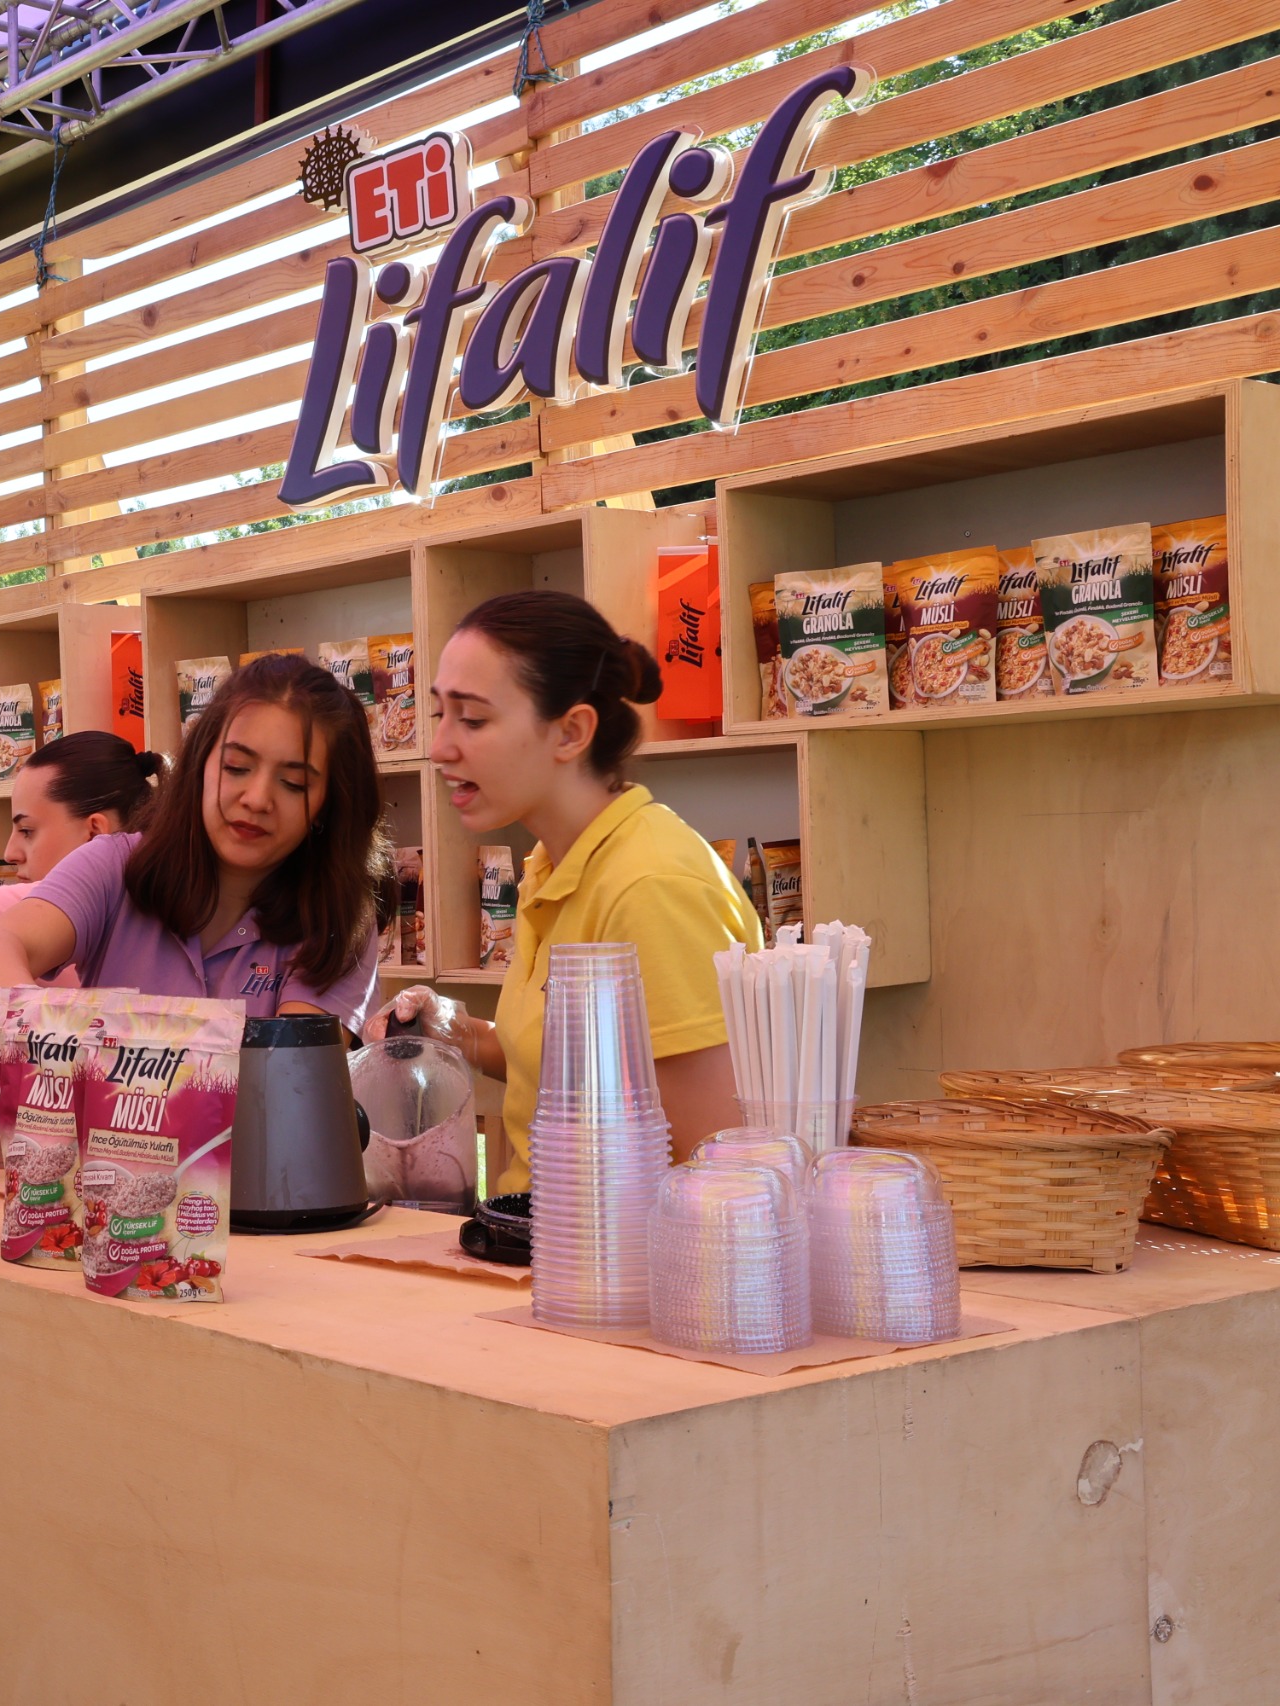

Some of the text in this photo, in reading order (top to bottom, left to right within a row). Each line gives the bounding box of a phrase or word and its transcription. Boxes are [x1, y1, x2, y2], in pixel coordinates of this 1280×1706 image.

[277, 64, 858, 505] Lifalif
[1071, 555, 1122, 583] Lifalif
[1161, 543, 1219, 573] Lifalif
[915, 574, 969, 601] Lifalif
[1072, 579, 1122, 605] GRANOLA
[1166, 571, 1202, 599] MÜSLİ
[802, 590, 855, 616] Lifalif
[920, 601, 955, 626] MÜSLİ
[997, 597, 1035, 620] MÜSLİ
[679, 598, 705, 669] Lifalif
[803, 613, 854, 635] GRANOLA
[27, 1030, 79, 1068] Lifali
[105, 1045, 189, 1091] Lifalif
[110, 1087, 169, 1132] MÜSLİ
[92, 1133, 174, 1153] İnce Öğütülmüş Yulaflı
[27, 1211, 44, 1219] DOĞAL
[123, 1221, 147, 1230] YÜKSEK
[121, 1246, 140, 1255] DOĞAL
